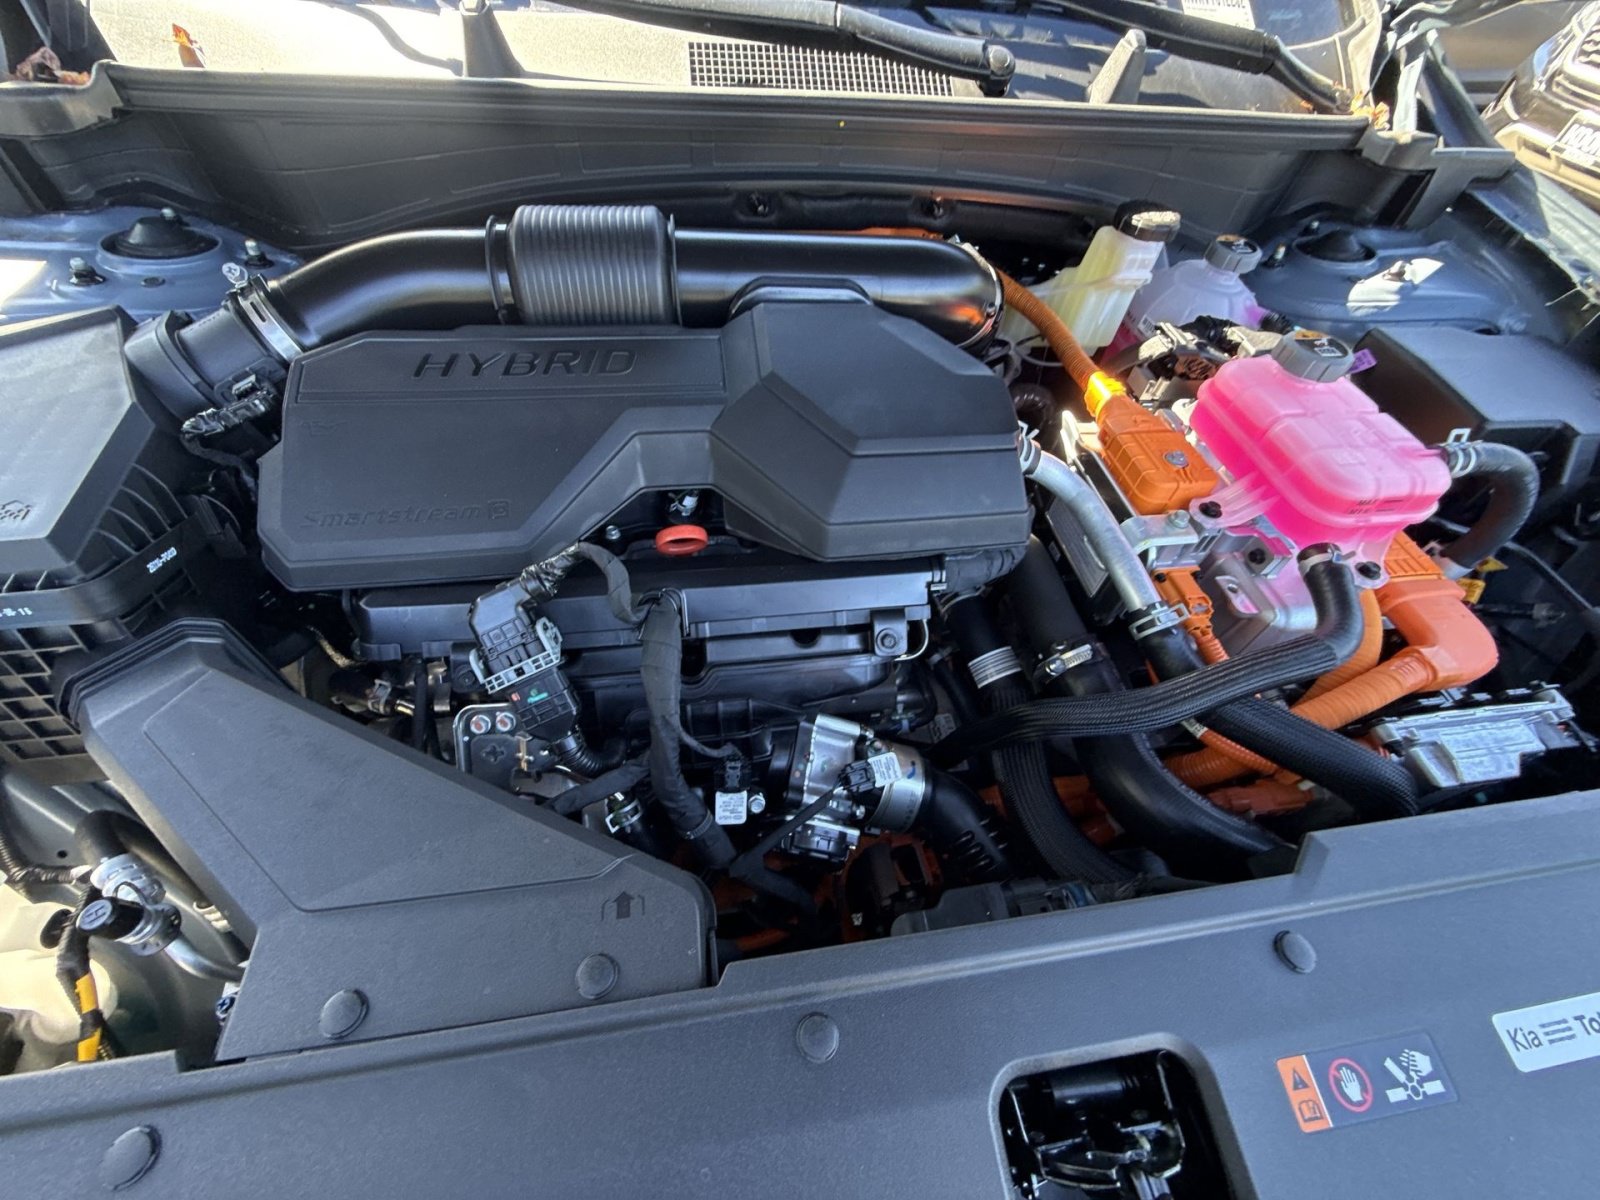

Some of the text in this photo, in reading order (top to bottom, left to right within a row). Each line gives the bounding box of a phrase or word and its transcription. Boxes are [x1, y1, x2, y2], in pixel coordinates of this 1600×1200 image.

[412, 351, 638, 378] HYBRID
[301, 503, 481, 528] Smartstream
[1506, 1012, 1600, 1052] Kia To
